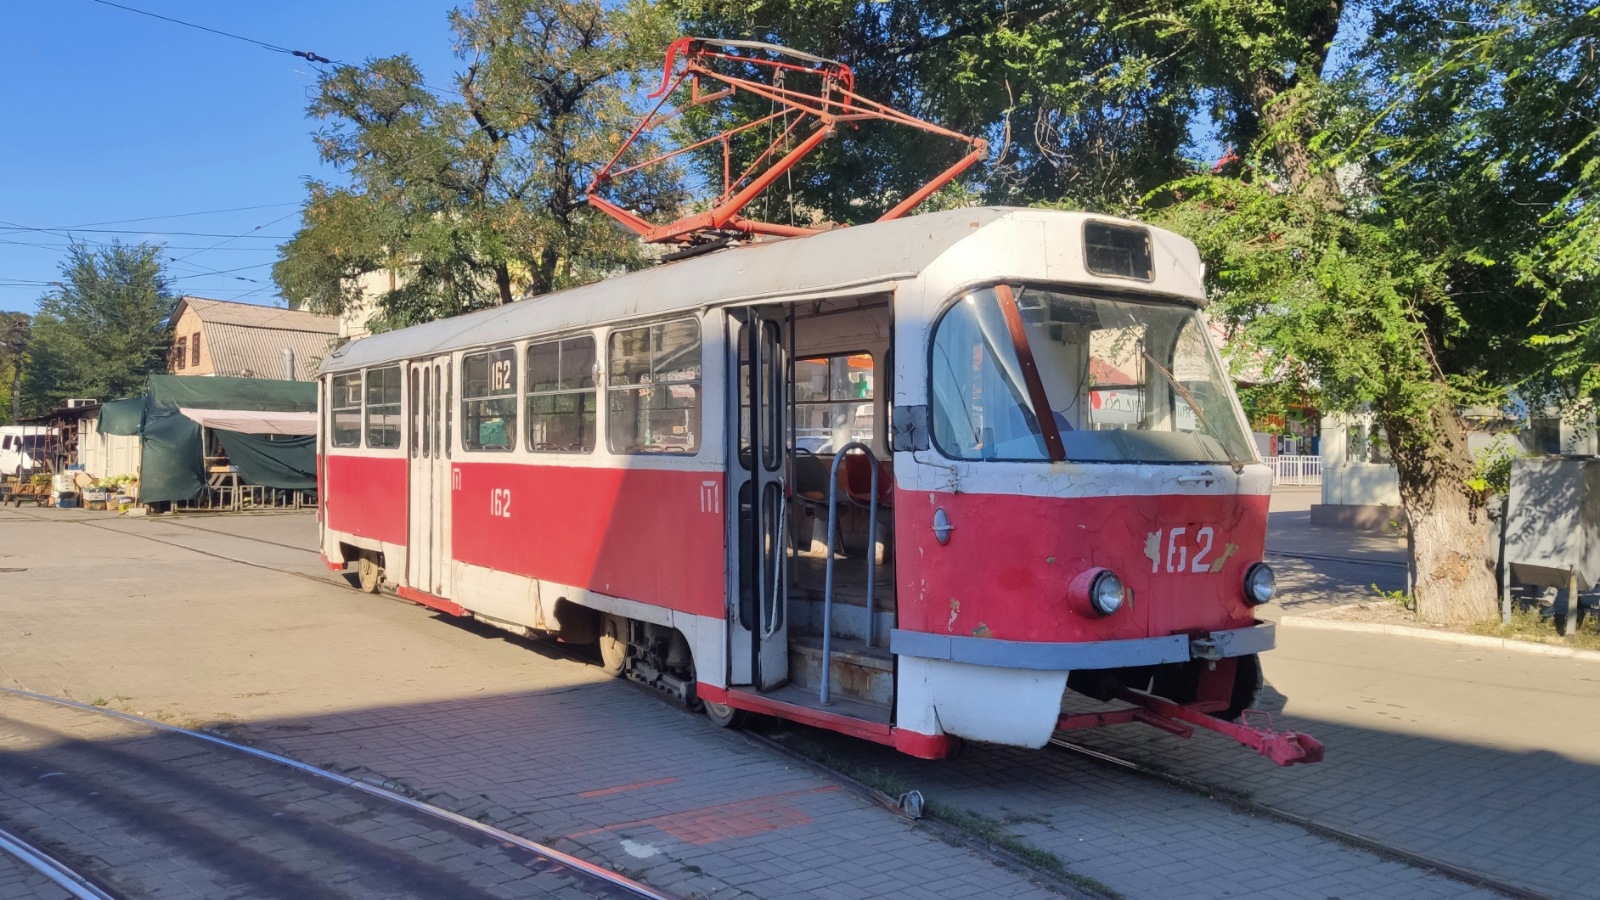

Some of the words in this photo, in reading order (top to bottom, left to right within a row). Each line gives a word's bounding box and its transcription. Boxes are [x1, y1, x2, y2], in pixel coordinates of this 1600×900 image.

[492, 359, 511, 391] 162
[490, 488, 511, 518] 162
[1146, 526, 1214, 573] 162
